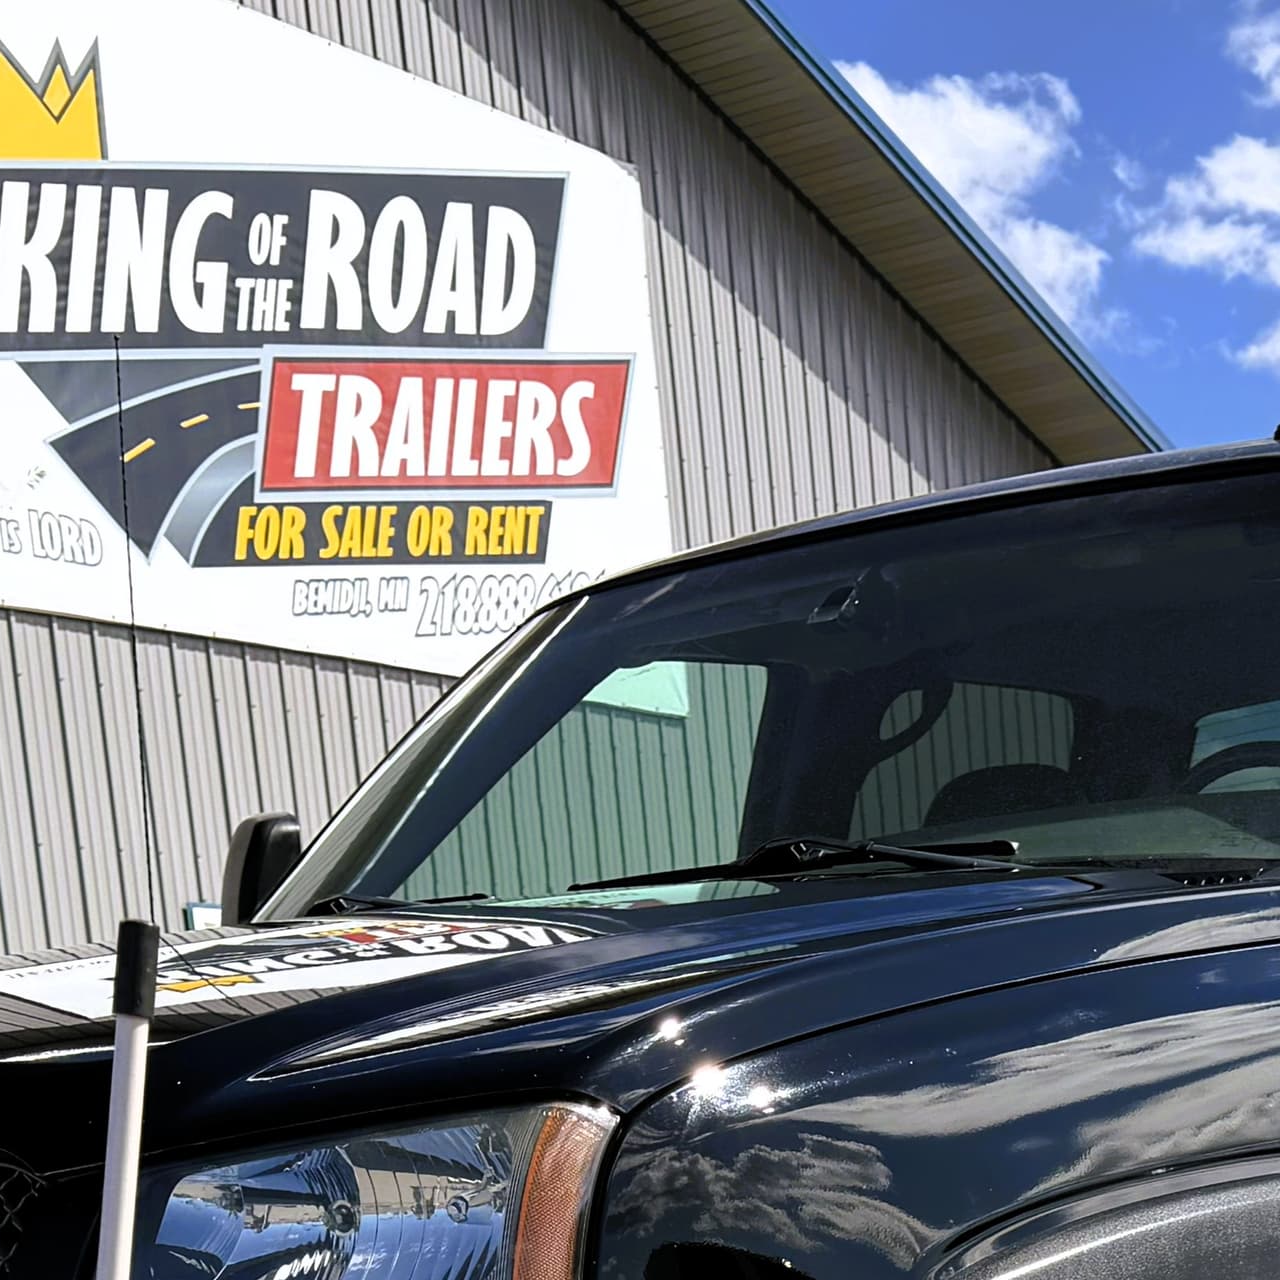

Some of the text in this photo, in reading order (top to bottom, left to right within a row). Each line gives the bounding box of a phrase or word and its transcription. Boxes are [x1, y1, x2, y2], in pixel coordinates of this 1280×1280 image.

[248, 212, 288, 266] OF
[300, 189, 536, 336] ROAD
[235, 277, 293, 332] THE
[291, 373, 595, 478] TRAILERS
[28, 508, 103, 567] LORD
[234, 505, 545, 560] FOR SALE OR RENT
[292, 578, 372, 618] BEMIDJI,
[378, 577, 409, 612] MN
